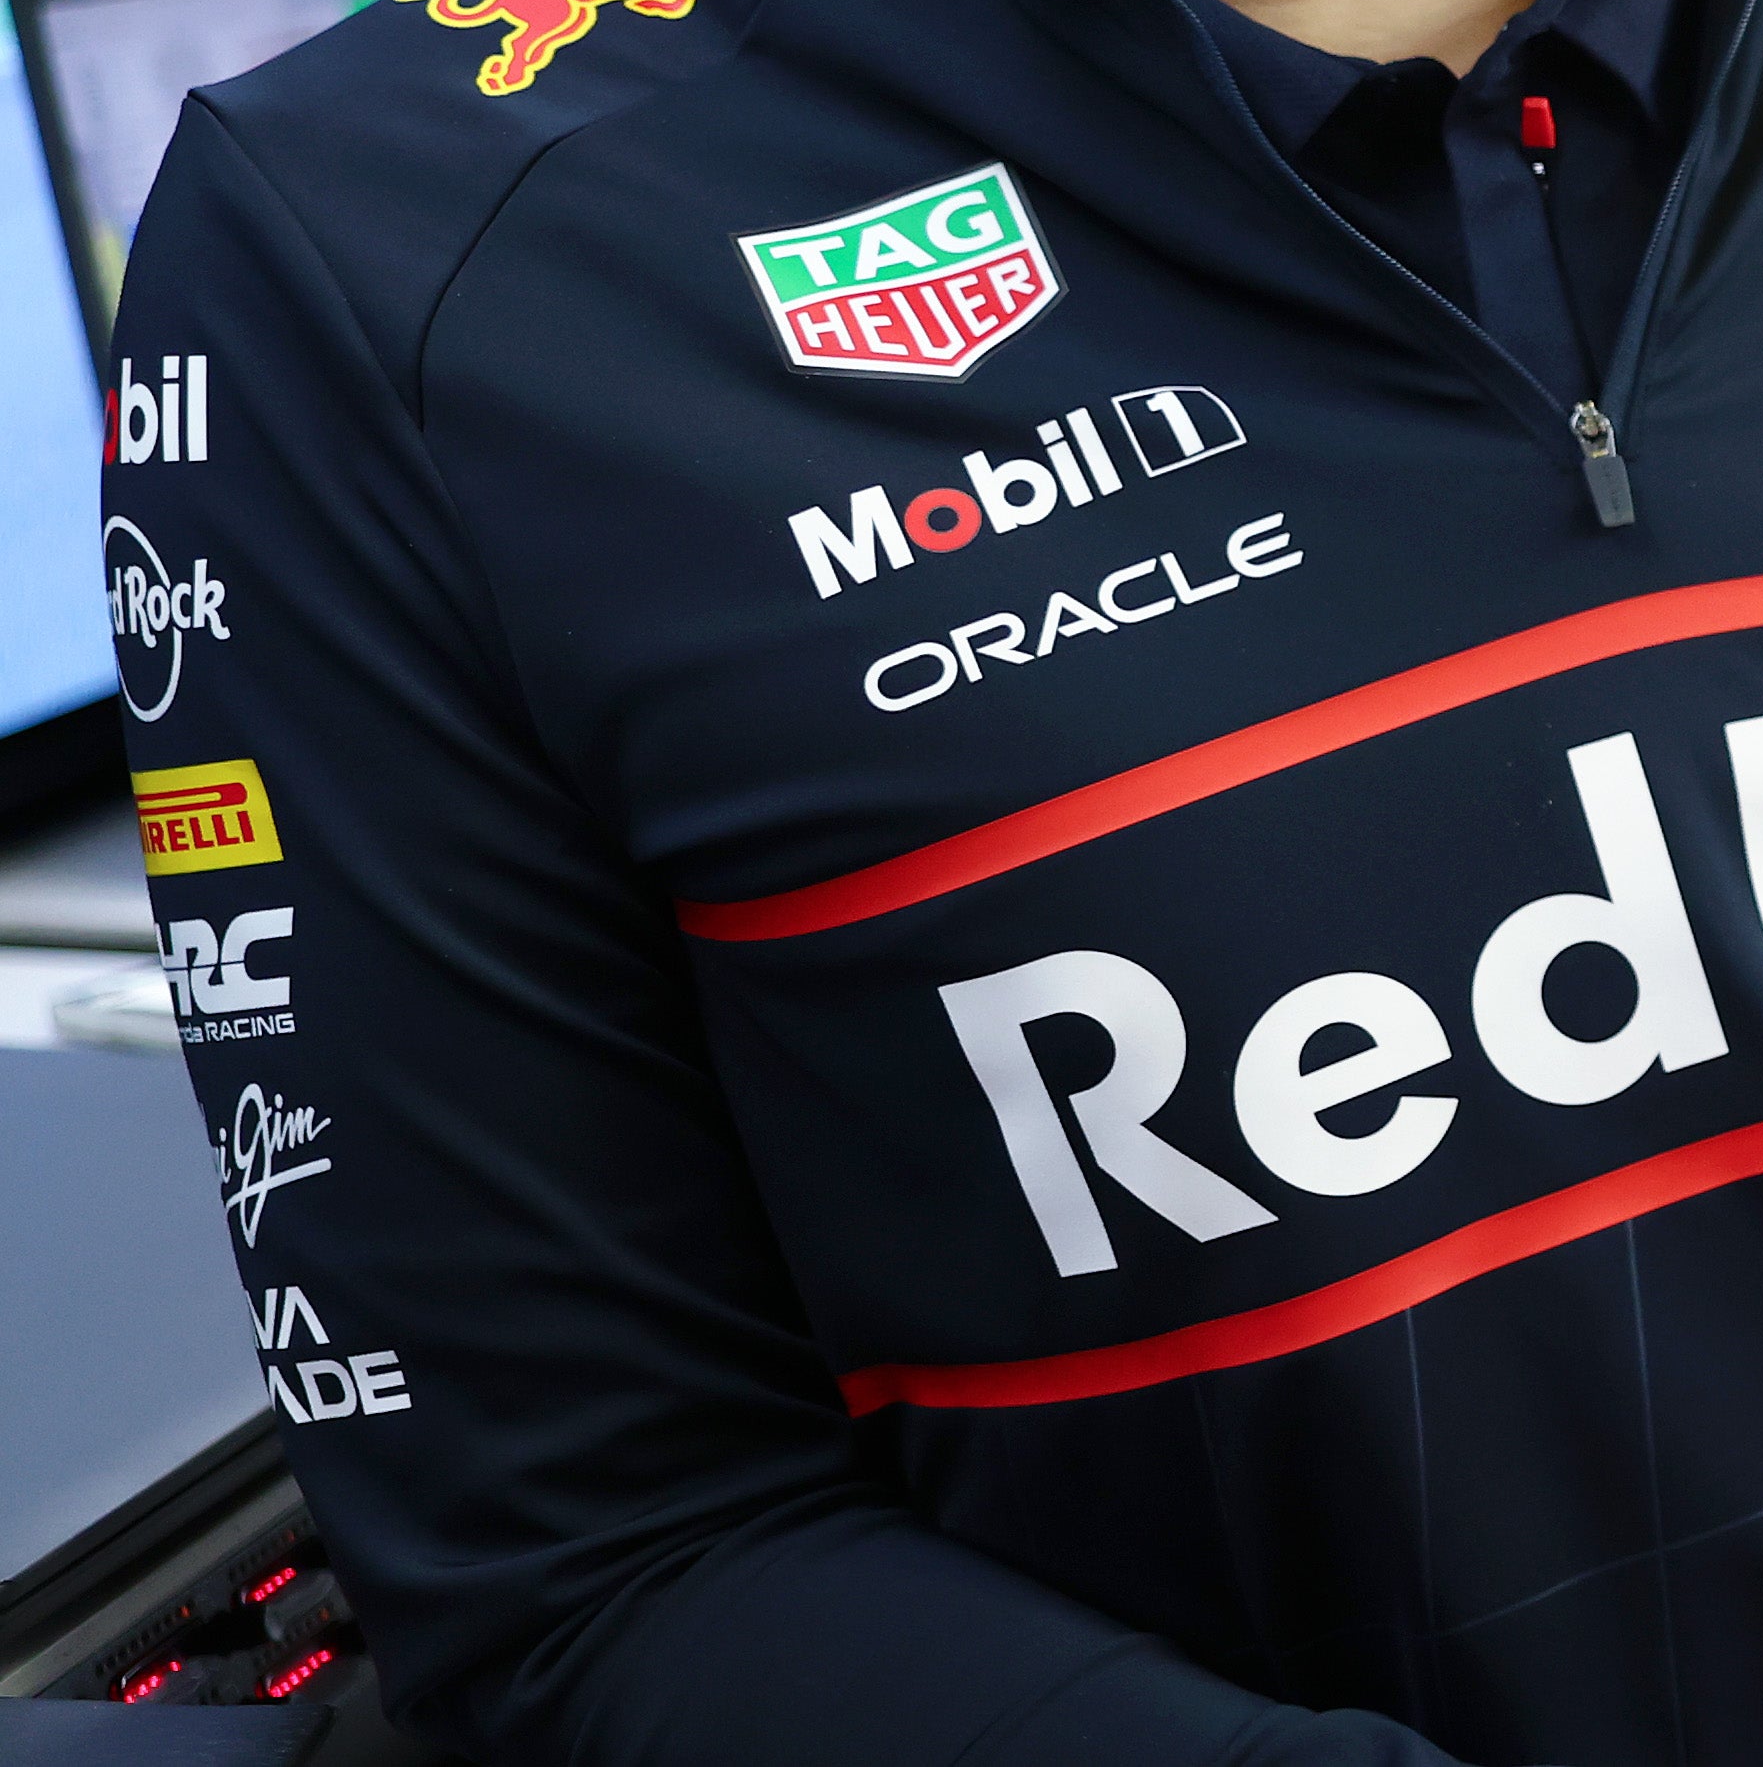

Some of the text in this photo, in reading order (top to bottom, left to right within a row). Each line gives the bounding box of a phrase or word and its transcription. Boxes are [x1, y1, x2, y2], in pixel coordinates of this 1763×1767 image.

[769, 190, 1005, 288] TAG
[796, 256, 1038, 361] HEUER
[104, 354, 208, 466] obil
[787, 407, 1123, 600] Mobil
[124, 558, 231, 649] Rock
[863, 512, 1304, 713] ORACLE
[204, 1012, 296, 1042] RACING
[936, 730, 1730, 1278] Red
[246, 1285, 331, 1351] VA
[268, 1349, 412, 1426] ADE
